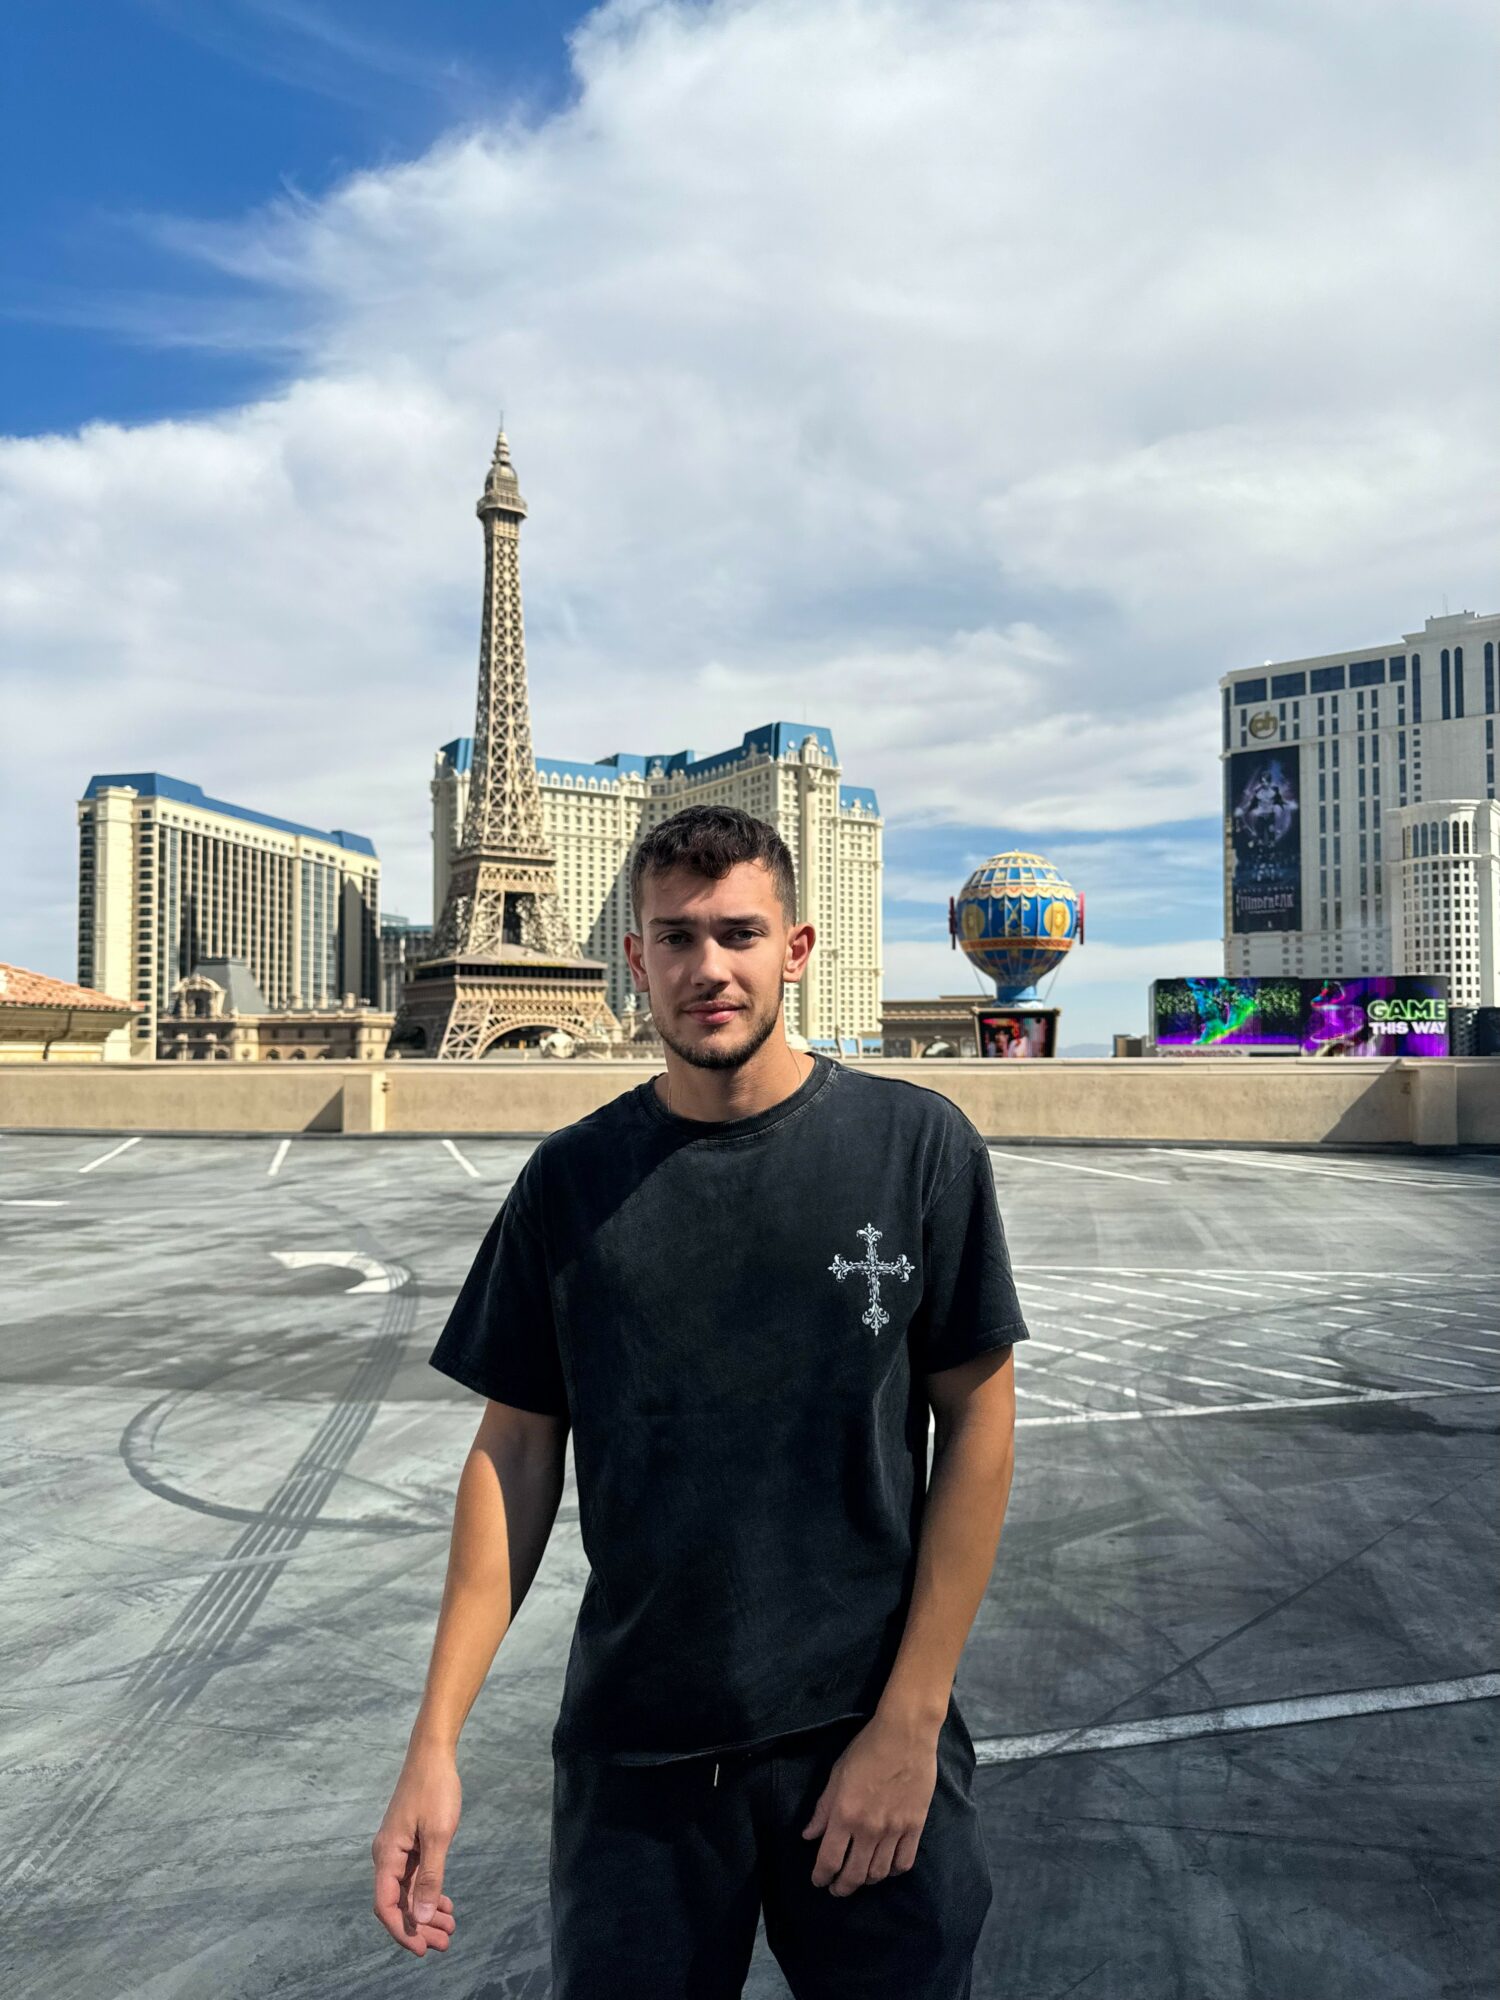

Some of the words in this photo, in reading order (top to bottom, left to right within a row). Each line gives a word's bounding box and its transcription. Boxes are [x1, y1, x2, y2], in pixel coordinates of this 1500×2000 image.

[1367, 999, 1447, 1020] GAME
[1368, 1021, 1409, 1034] THIS
[1411, 1022, 1447, 1034] WAY
